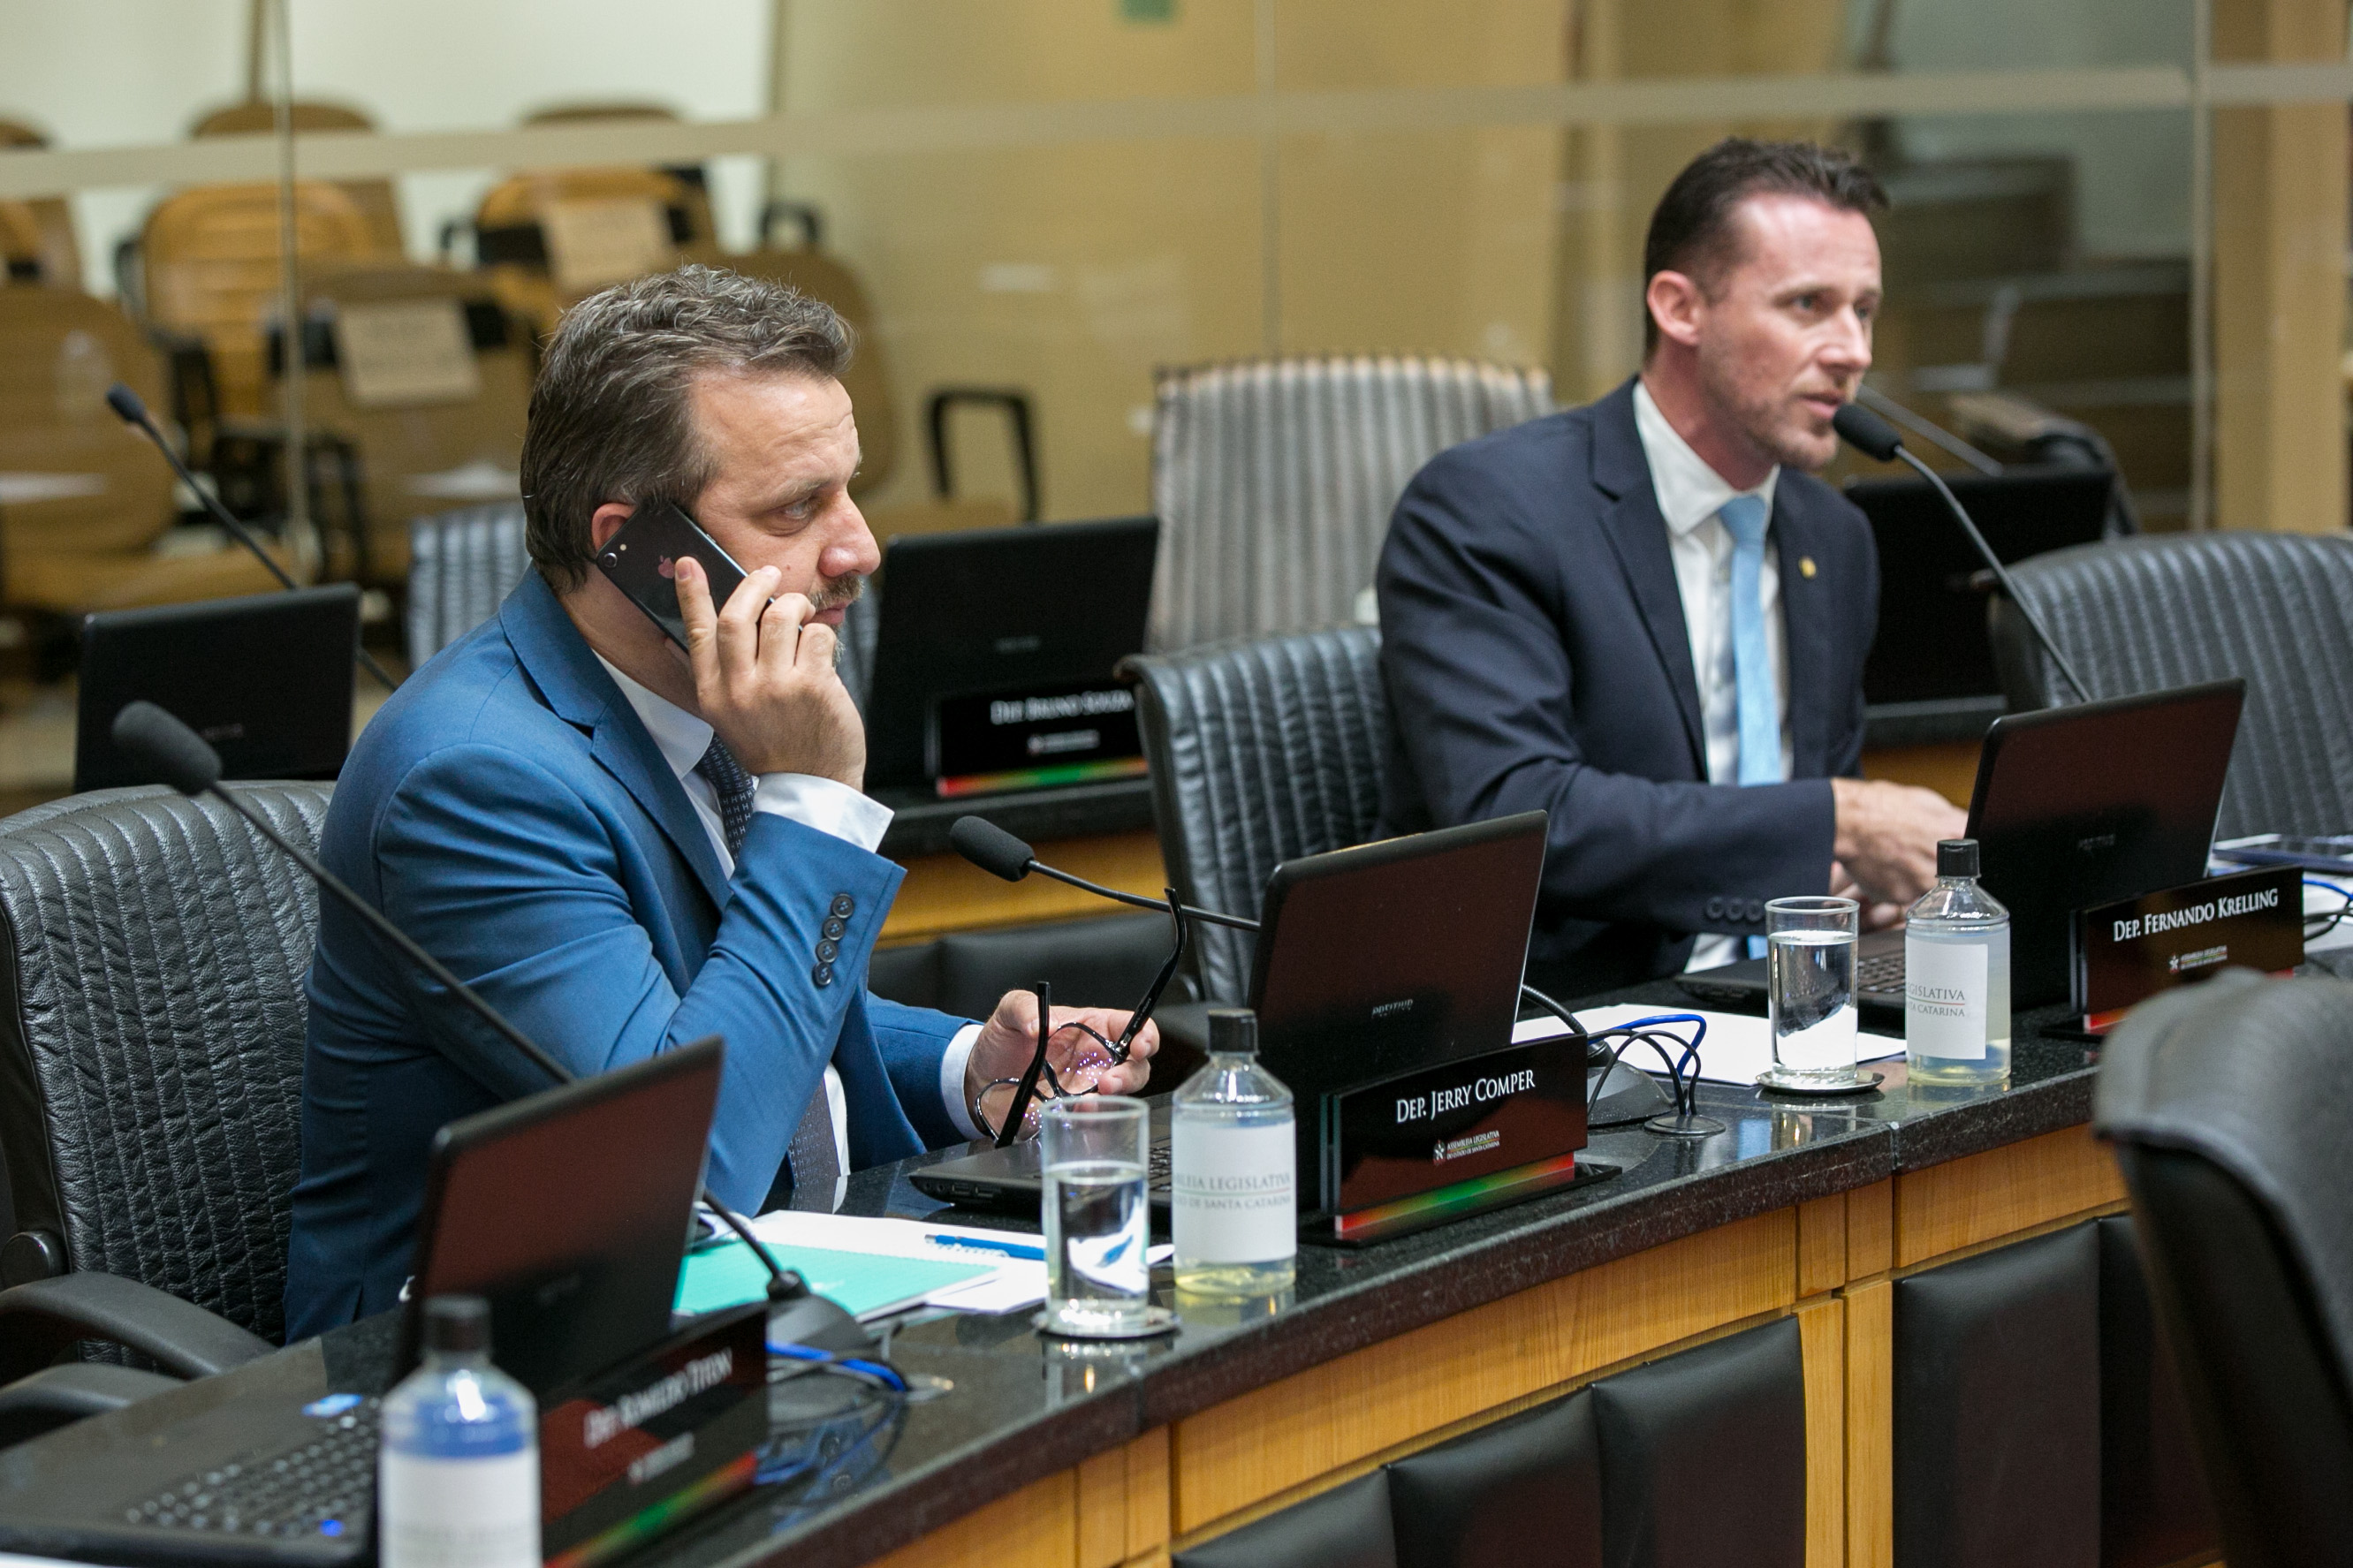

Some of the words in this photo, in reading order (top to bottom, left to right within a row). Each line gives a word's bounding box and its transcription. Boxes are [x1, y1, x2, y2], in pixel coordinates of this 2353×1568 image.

[2113, 920, 2141, 943] DEP.
[2144, 902, 2215, 935] FERNANDO
[2218, 888, 2279, 919] KRELLING
[1917, 1005, 1965, 1018] CATARINA
[1396, 1097, 1427, 1124] DEP.
[1431, 1084, 1473, 1121] JERRY
[1475, 1069, 1536, 1102] COMPER
